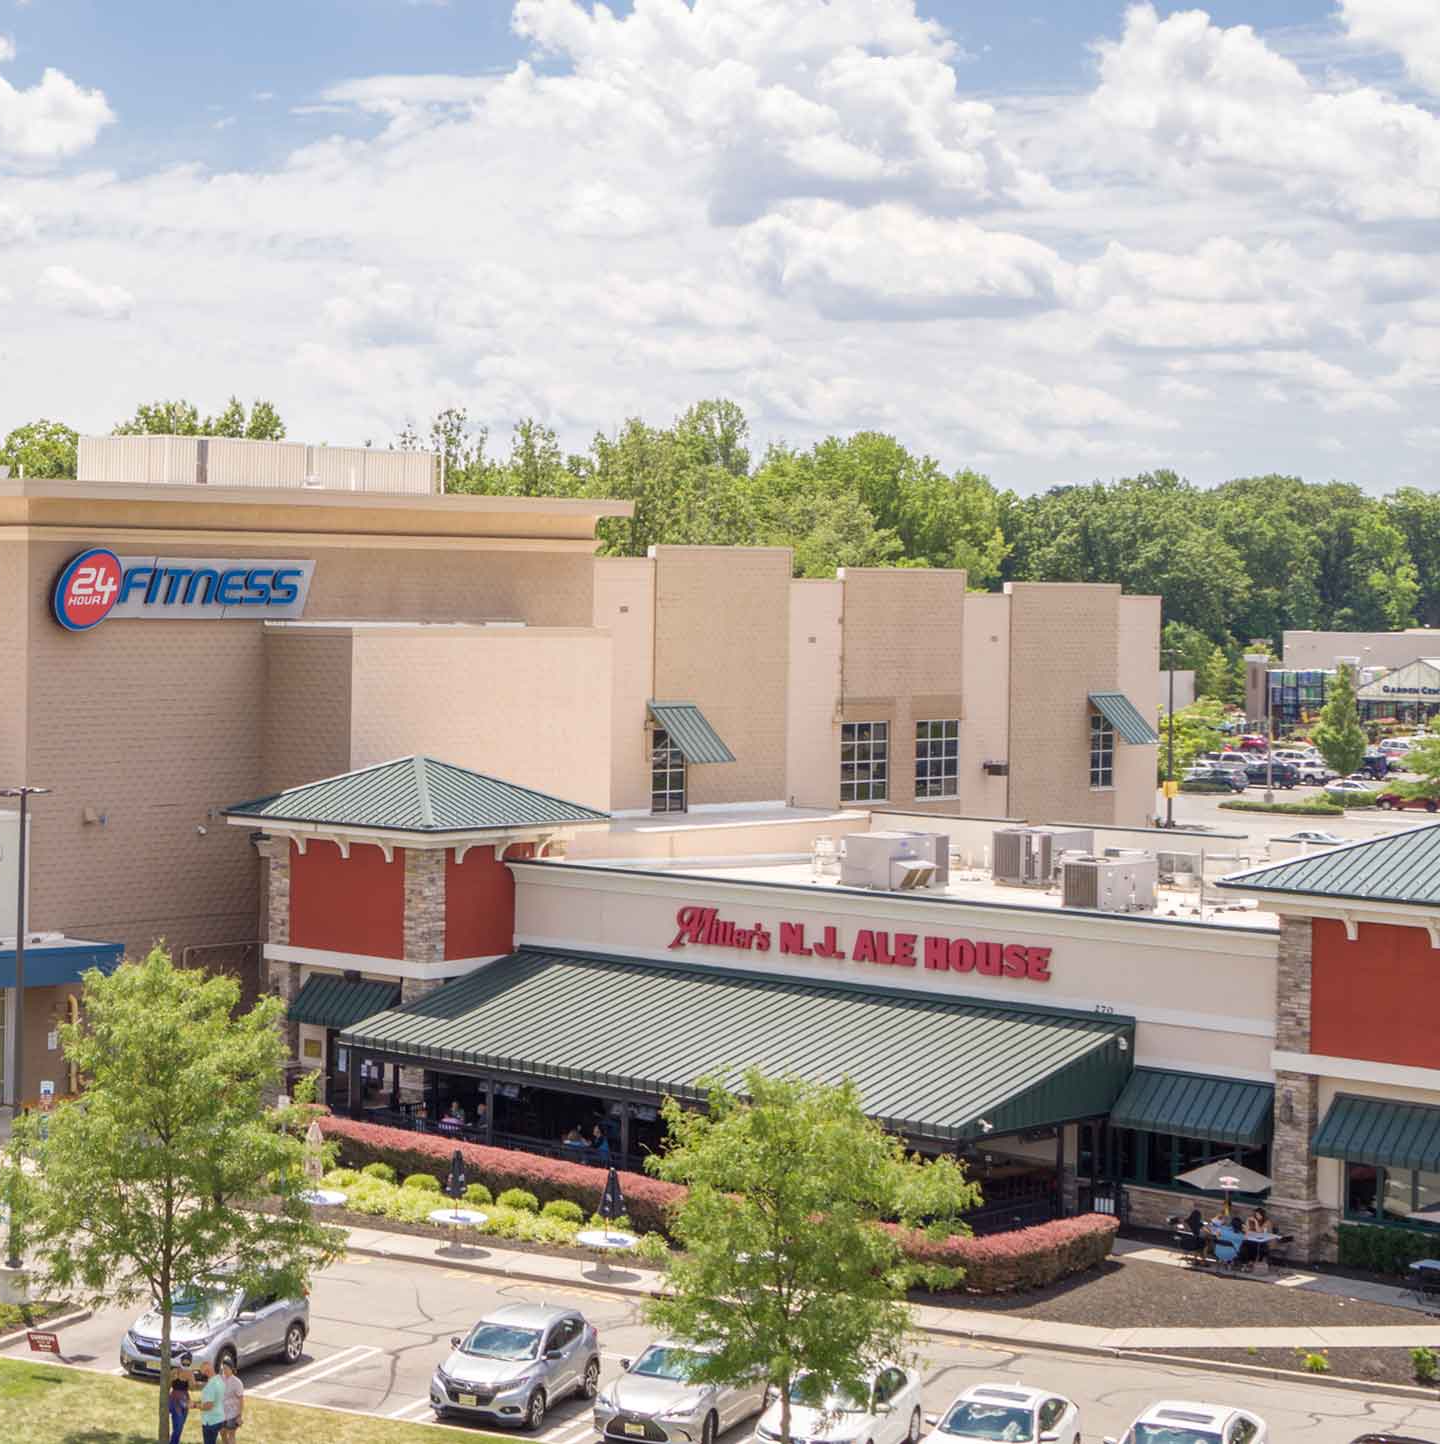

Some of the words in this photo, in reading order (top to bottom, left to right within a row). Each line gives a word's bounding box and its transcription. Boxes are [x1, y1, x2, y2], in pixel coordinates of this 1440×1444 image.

[67, 595, 101, 606] HOUR
[71, 567, 118, 605] 24
[116, 567, 303, 606] FITNESS
[667, 905, 771, 952] Miller's
[852, 929, 918, 967] ALE
[923, 935, 1053, 982] HOUSE
